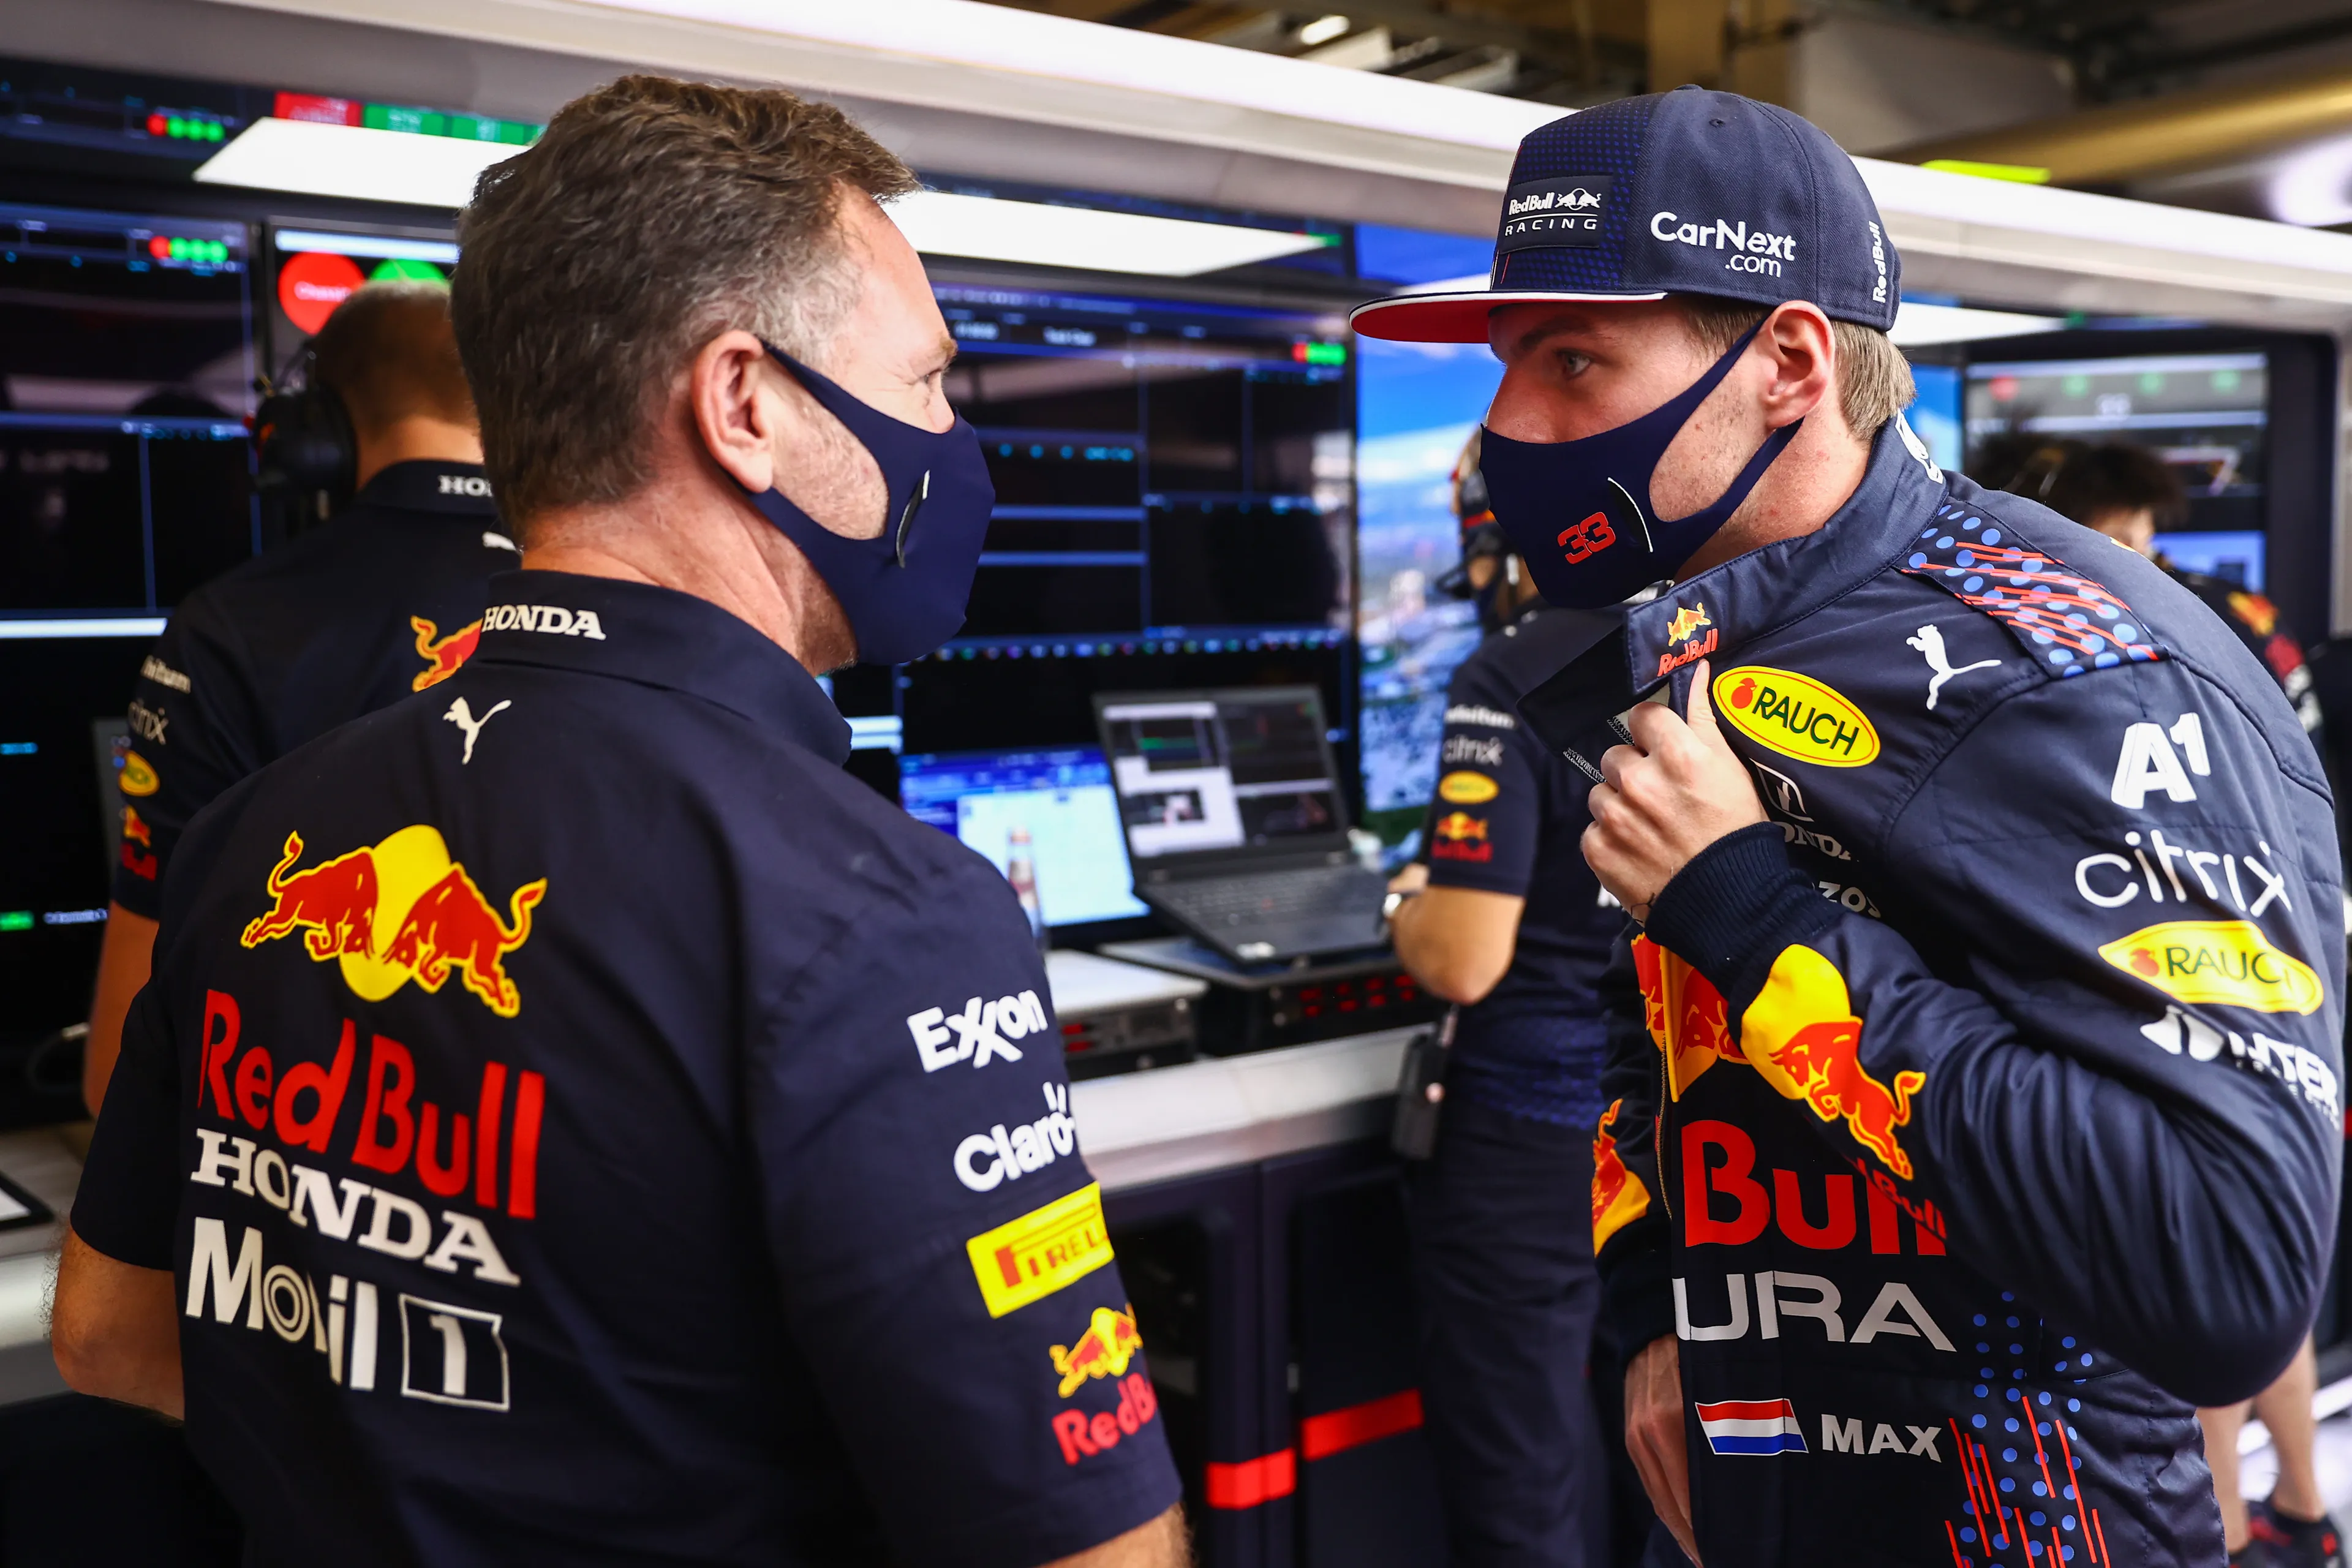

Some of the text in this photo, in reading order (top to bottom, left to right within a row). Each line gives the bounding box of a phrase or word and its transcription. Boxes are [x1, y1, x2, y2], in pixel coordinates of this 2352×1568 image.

[1505, 218, 1597, 236] RACING
[1650, 211, 1796, 262] CarNext
[1724, 251, 1782, 278] .com
[437, 475, 492, 497] HO
[1557, 511, 1616, 564] 33
[481, 604, 606, 641] HONDA
[1752, 684, 1860, 756] RAUCH
[2111, 712, 2211, 810] A1
[2075, 829, 2293, 917] citrix
[907, 990, 1048, 1073] Exxon
[954, 1102, 1076, 1192] Claro
[190, 1128, 521, 1286] HONDA
[993, 1203, 1109, 1288] PIREL
[430, 1314, 468, 1396] 1
[1821, 1414, 1942, 1463] MAX
